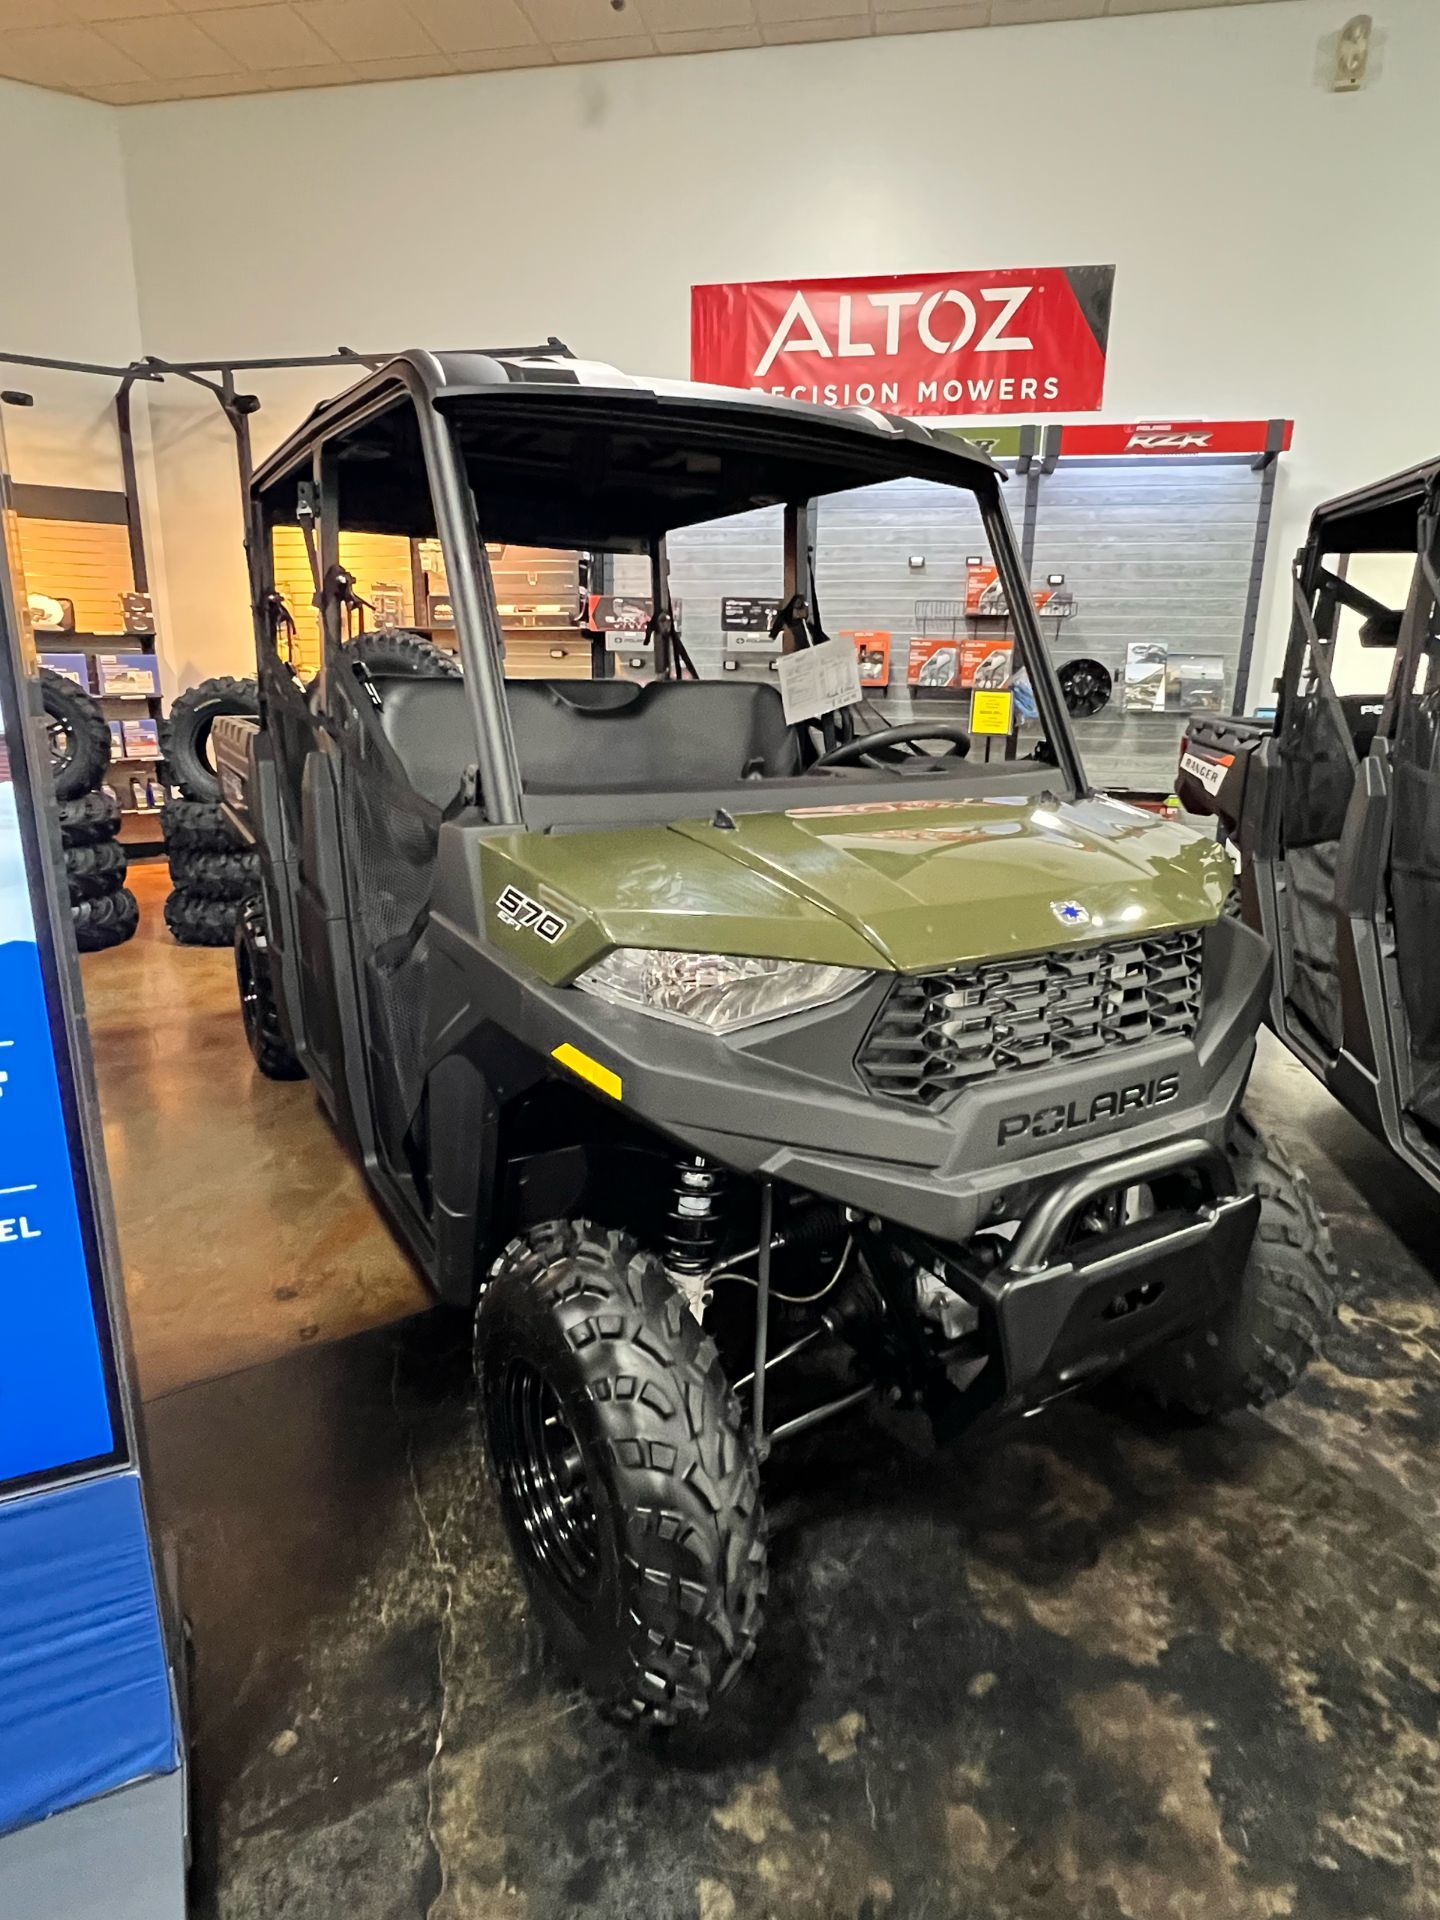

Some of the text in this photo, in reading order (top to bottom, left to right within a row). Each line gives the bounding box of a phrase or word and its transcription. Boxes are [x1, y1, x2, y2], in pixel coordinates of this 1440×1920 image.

[753, 286, 1035, 377] ALTOZ
[918, 377, 1059, 403] MOWERS
[1124, 431, 1214, 451] RZR
[1185, 758, 1219, 783] RANGER
[496, 884, 567, 944] 570
[997, 1071, 1180, 1147] POLARIS
